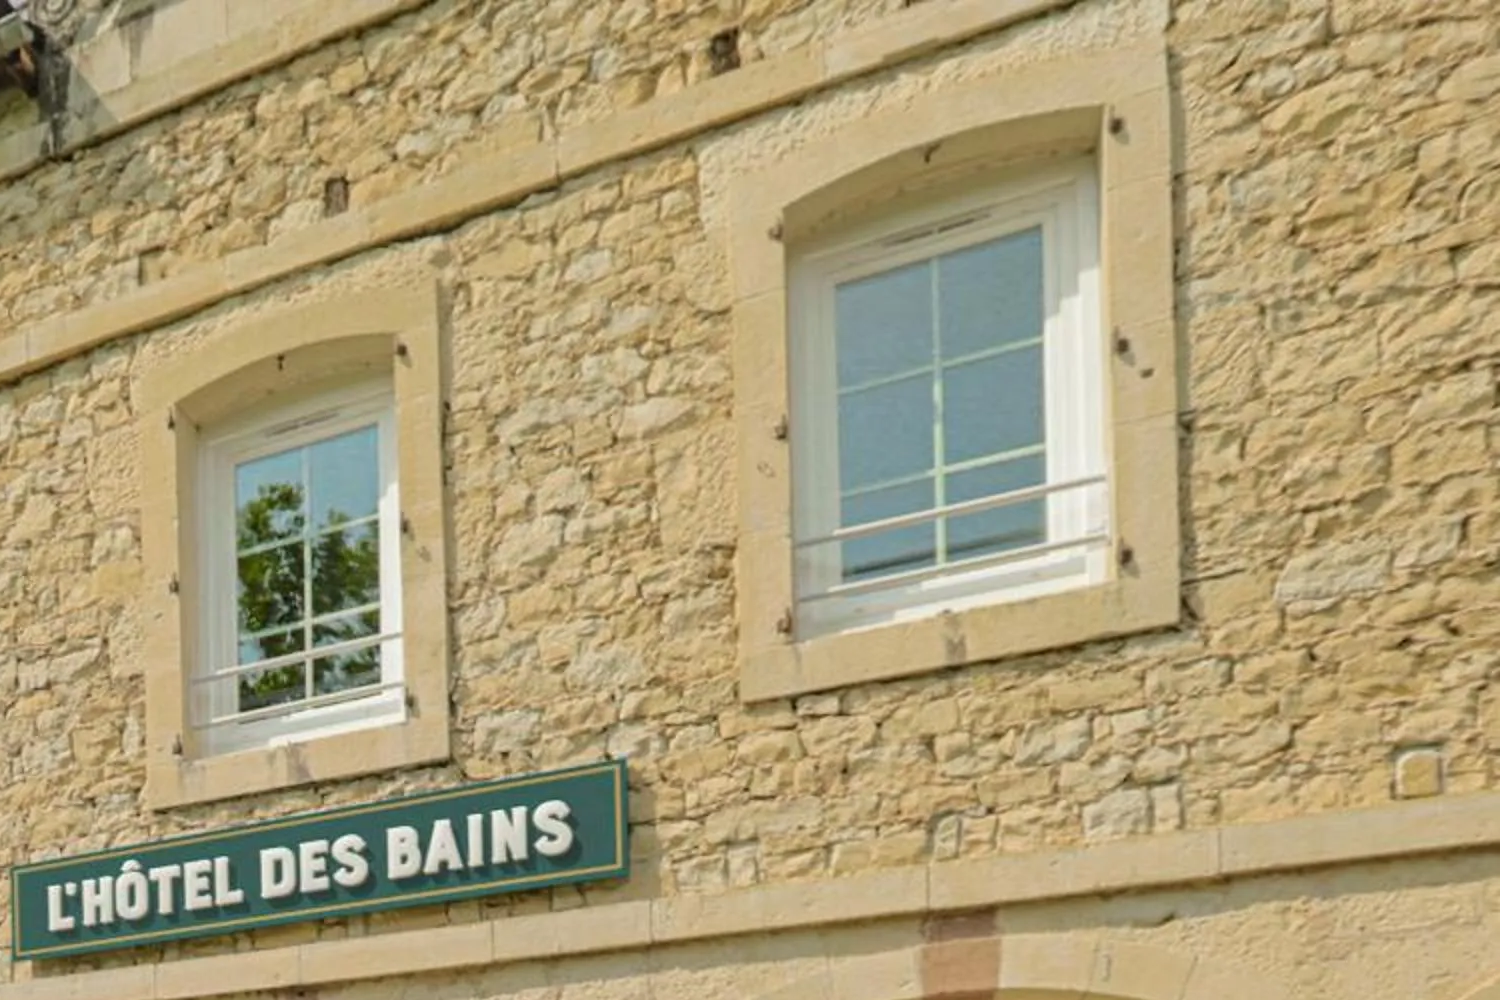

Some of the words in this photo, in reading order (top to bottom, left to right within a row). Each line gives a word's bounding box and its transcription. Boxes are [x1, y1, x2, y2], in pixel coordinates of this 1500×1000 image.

[47, 856, 243, 931] L'HÔTEL
[259, 833, 368, 899] DES
[385, 798, 573, 880] BAINS
